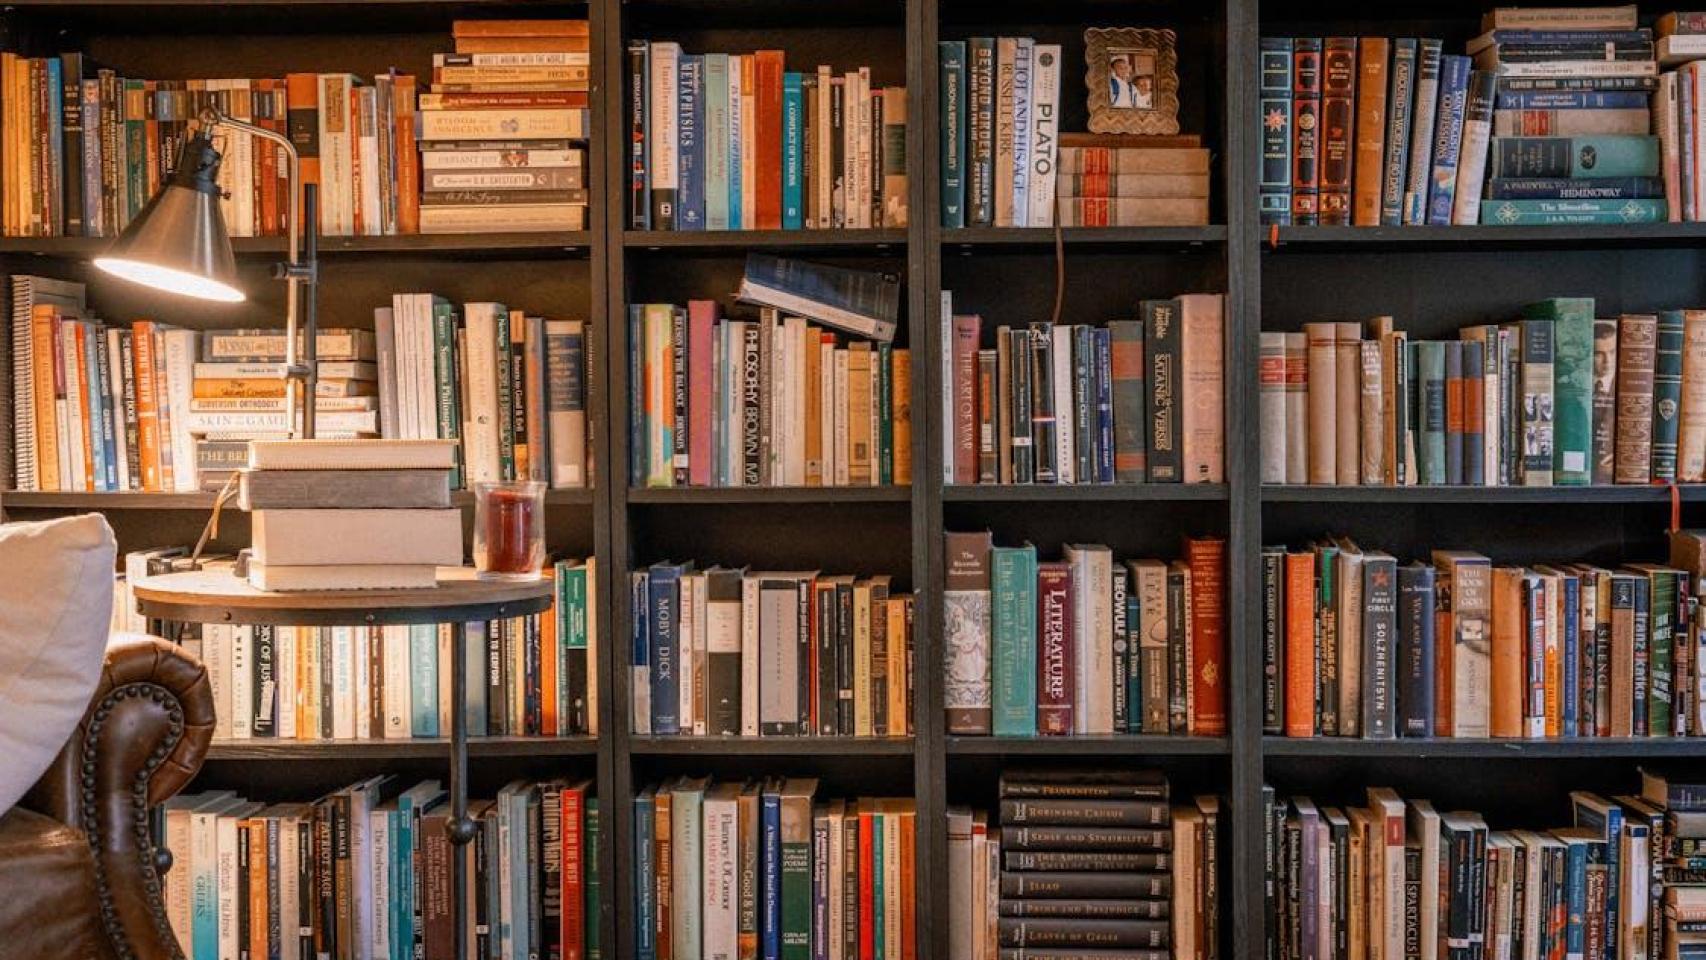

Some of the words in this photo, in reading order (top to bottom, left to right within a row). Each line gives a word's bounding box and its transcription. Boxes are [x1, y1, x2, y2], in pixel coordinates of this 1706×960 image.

[979, 48, 992, 104] BEYOND
[1014, 47, 1028, 90] ELIOT
[1000, 63, 1012, 118] RUSSELL
[1396, 62, 1408, 108] AROUND
[680, 63, 694, 146] METAPHYSICS
[1014, 96, 1028, 128] AND
[1452, 90, 1462, 114] SAINT
[788, 108, 796, 144] CONFLICT
[979, 112, 992, 158] ORDER
[1000, 122, 1012, 157] KIRK
[1036, 104, 1052, 176] PLATO
[1392, 119, 1405, 154] WORLD
[1436, 94, 1452, 158] CONFESSIONS
[1448, 117, 1460, 165] AUGUSTINE
[788, 146, 796, 156] OF
[1512, 182, 1554, 190] FAREWELL
[1560, 188, 1621, 198] HEMINGWAY
[1540, 204, 1554, 212] The
[674, 316, 684, 346] REASON
[440, 346, 449, 383] Summa
[674, 348, 684, 356] IN
[674, 358, 684, 372] THE
[746, 330, 758, 404] PHILOSOPHY
[960, 351, 972, 376] THE
[674, 374, 684, 408] BALANCE
[960, 376, 972, 400] ART
[1154, 354, 1168, 406] SATANIC
[127, 401, 135, 422] DOOR
[514, 390, 523, 410] Good
[960, 402, 972, 419] OF
[199, 416, 232, 426] SKIN
[516, 418, 524, 432] Evil
[674, 416, 684, 448] JOHNSON
[746, 407, 758, 456] BROWN
[960, 420, 972, 449] WAR
[1154, 410, 1168, 450] VERSES
[200, 450, 224, 461] THE
[1001, 560, 1015, 587] The
[658, 598, 670, 638] MOBY
[1001, 592, 1015, 628] Book
[1114, 576, 1126, 636] BEOWULF
[1412, 598, 1422, 620] WAR
[490, 640, 498, 650] TO
[1001, 632, 1015, 644] of
[1050, 590, 1066, 699] LITERATURE
[1412, 623, 1422, 644] AND
[1634, 611, 1648, 652] franz
[260, 645, 270, 662] OF
[490, 652, 498, 686] SERFDOM
[658, 646, 670, 681] DICK
[1376, 622, 1386, 710] SOLZHENITSYN
[1412, 647, 1422, 678] PEACE
[1598, 629, 1608, 690] SILENCE
[1001, 648, 1015, 700] Virtues
[1634, 658, 1648, 700] kafka
[568, 798, 578, 811] THE
[1030, 808, 1079, 818] ROBINSON
[1084, 808, 1124, 818] CRUSOE
[322, 821, 331, 866] PATRIOT
[375, 830, 385, 842] The
[568, 832, 578, 843] ON
[720, 812, 732, 858] Flannery
[1031, 832, 1062, 842] SENSE
[1065, 833, 1085, 842] AND
[1088, 832, 1148, 843] SENSIBILITY
[1652, 820, 1663, 879] BEOWULF
[544, 841, 560, 873] Wars
[568, 846, 578, 860] THE
[322, 869, 331, 897] SAGE
[568, 862, 578, 884] WEST
[720, 860, 732, 910] O'Connor
[743, 869, 754, 898] Good
[767, 874, 775, 891] Road
[1030, 882, 1060, 891] ILIAD
[196, 876, 206, 919] GREEKS
[743, 899, 754, 908] &
[1026, 904, 1057, 914] PRIDE
[1062, 905, 1081, 914] AND
[1086, 904, 1140, 914] PREJUDICE
[375, 897, 385, 945] Controversy
[743, 910, 754, 930] Evil
[1406, 884, 1418, 952] SPARTACUS
[1030, 932, 1064, 942] LEAVES
[1069, 932, 1082, 942] OF
[1086, 932, 1118, 942] GRASS
